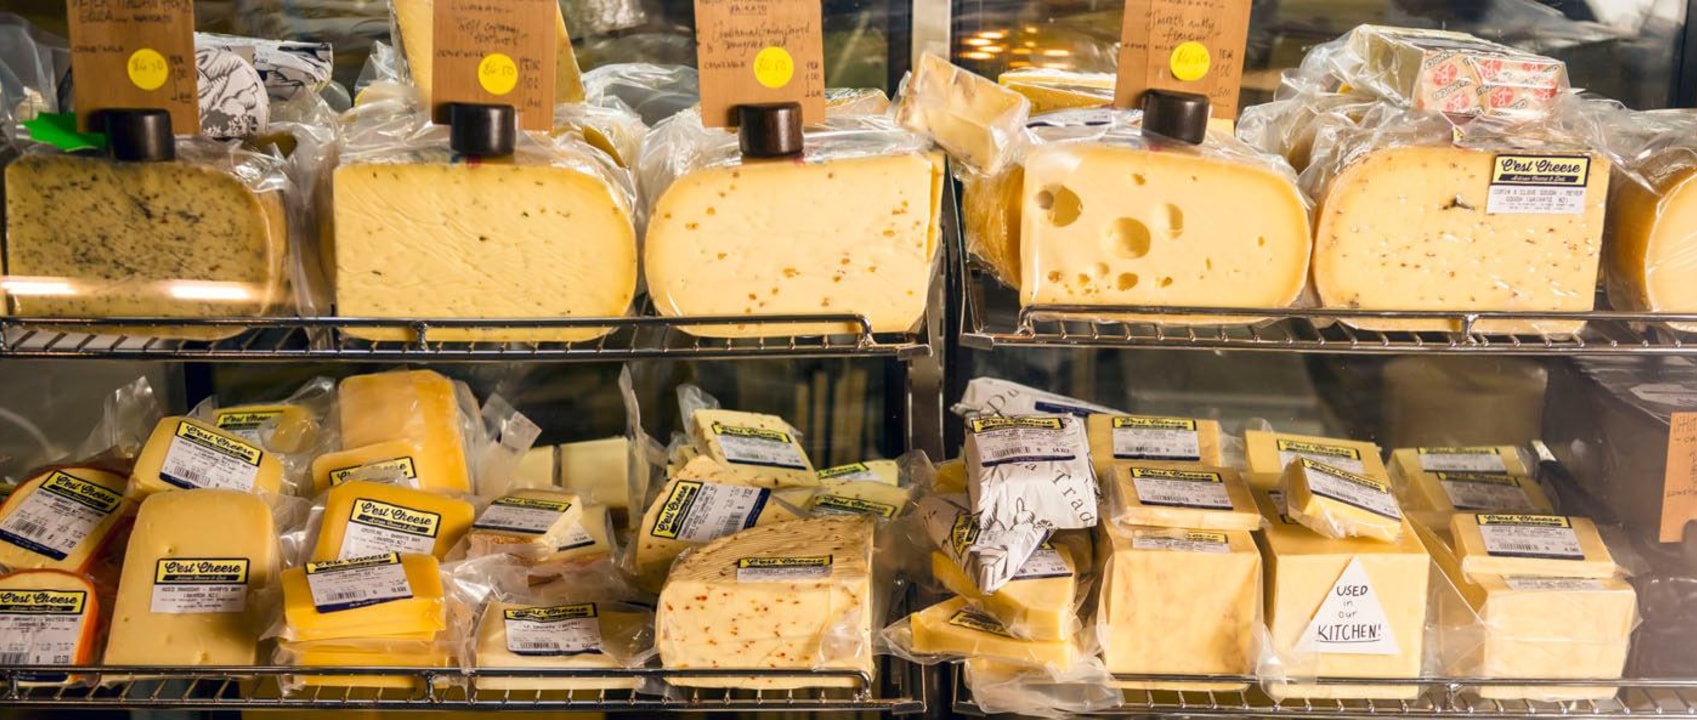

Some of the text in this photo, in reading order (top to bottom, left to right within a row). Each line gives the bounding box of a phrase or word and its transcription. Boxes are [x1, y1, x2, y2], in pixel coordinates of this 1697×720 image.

[1501, 158, 1582, 173] C'est Cheese
[186, 425, 255, 456] C'est Cheese
[1170, 470, 1213, 478] Cheese
[55, 475, 116, 504] C'est Cheese
[361, 502, 432, 525] C'est Cheese
[657, 485, 688, 532] C'est Cheese
[164, 561, 242, 574] C'est Cheese
[0, 592, 78, 604] C'est Cheese
[1336, 585, 1368, 597] USED
[1338, 611, 1357, 619] our
[1318, 624, 1381, 641] KITCHEN!
